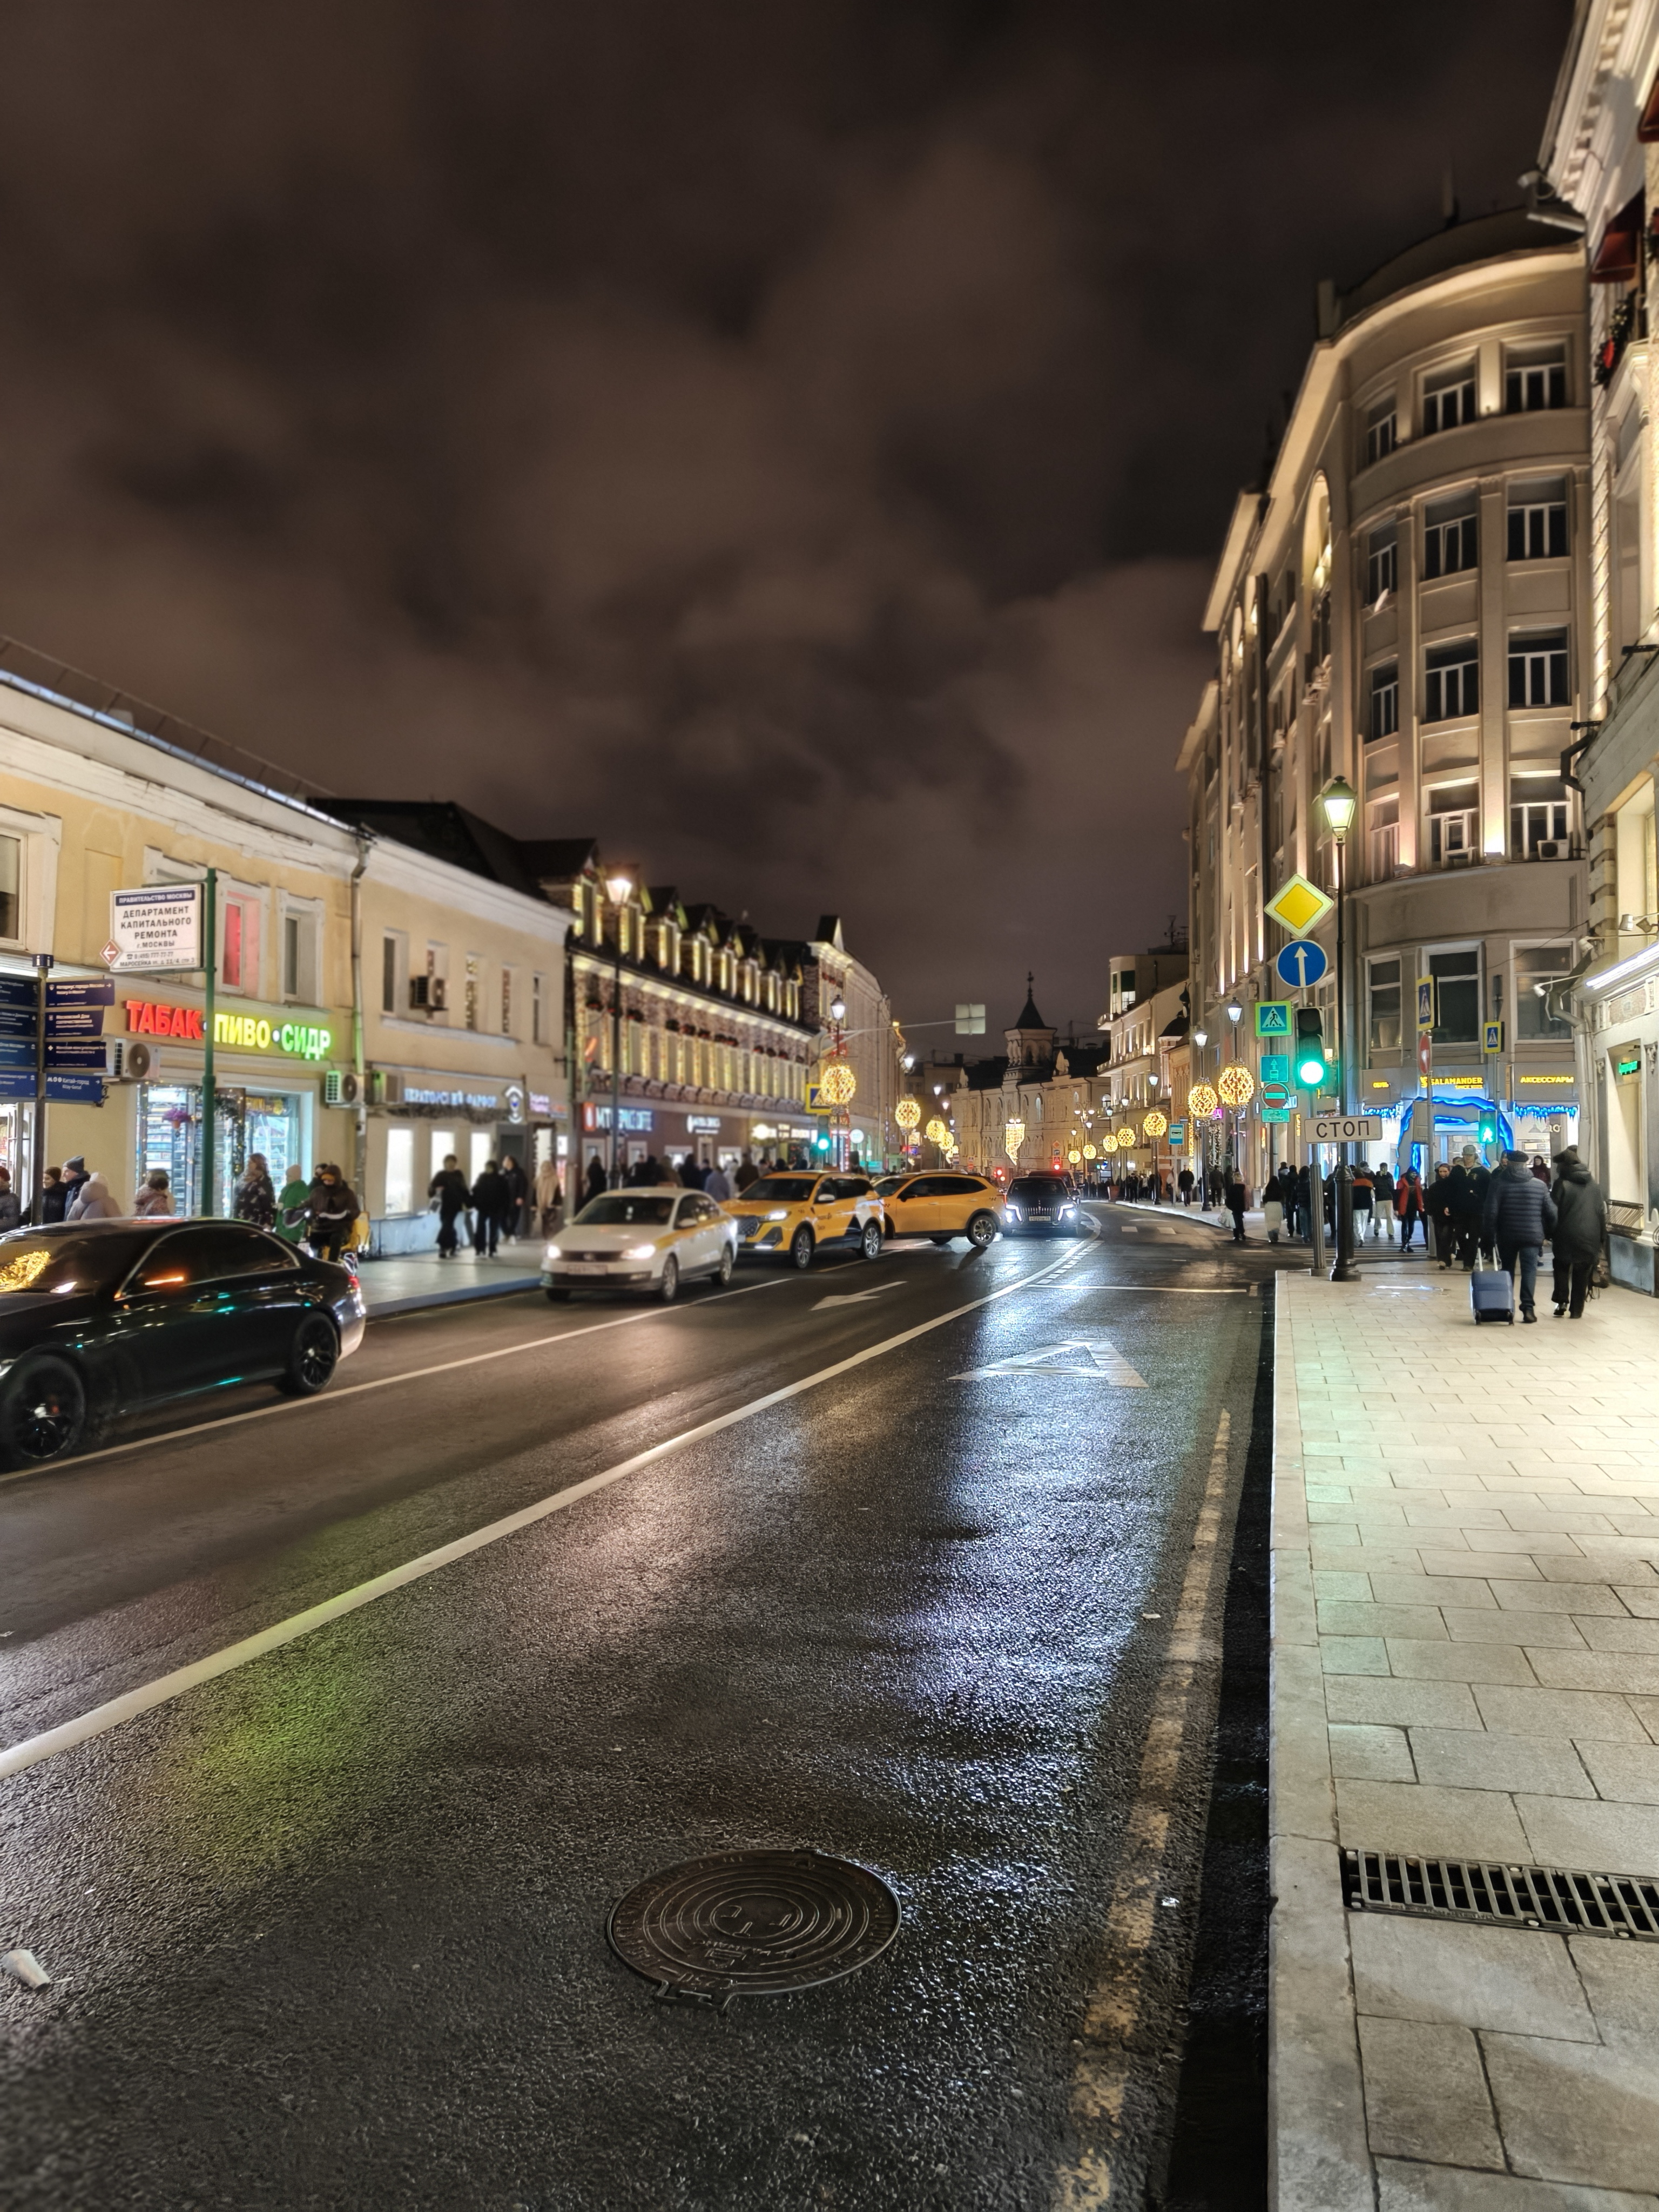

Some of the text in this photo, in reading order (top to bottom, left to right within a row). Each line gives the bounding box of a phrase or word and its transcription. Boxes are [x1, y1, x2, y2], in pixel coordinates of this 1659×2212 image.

[119, 895, 166, 903] ПРАВИТЕЛЬСТВО
[123, 906, 189, 919] ДЕПАРТАМЕНТ
[120, 917, 191, 929] КАПИТАЛЬНОГО
[134, 929, 178, 939] РЕМОНТА
[126, 1000, 331, 1061] ТАБАК ПИВО СИДР
[1431, 1077, 1483, 1085] SALAMANDER
[1316, 1120, 1370, 1138] СТОП
